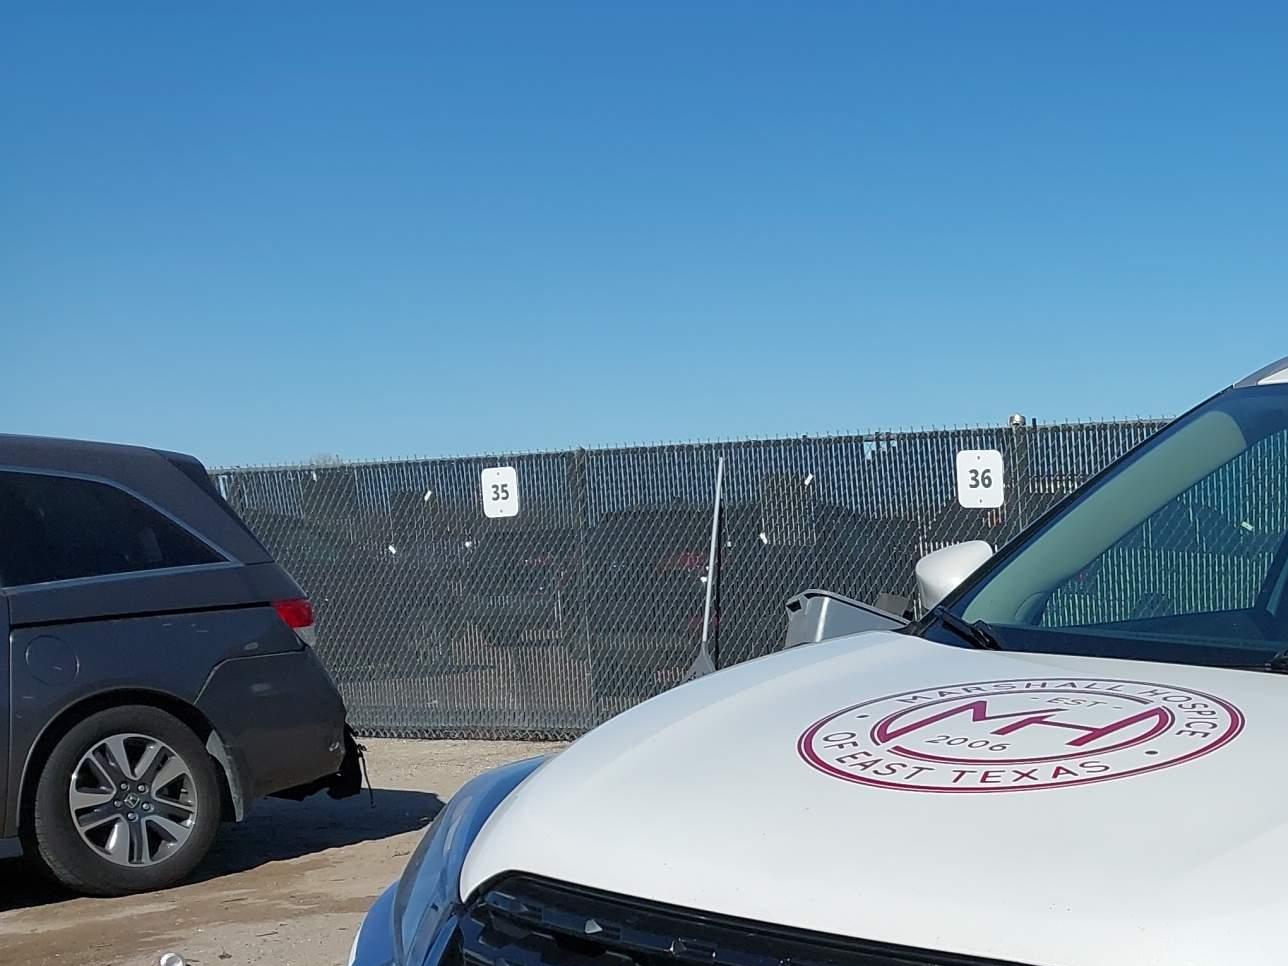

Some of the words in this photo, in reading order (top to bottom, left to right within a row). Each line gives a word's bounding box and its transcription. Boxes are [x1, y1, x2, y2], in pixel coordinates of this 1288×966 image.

[968, 468, 992, 489] 36
[491, 483, 509, 501] 35
[896, 681, 1125, 704] MARSHALL
[1137, 689, 1219, 739] HOSPICE
[1046, 696, 1109, 709] EST
[822, 731, 859, 750] OF
[925, 735, 1011, 752] 2006
[835, 750, 936, 780] EAST
[951, 760, 1111, 784] TEXAS
